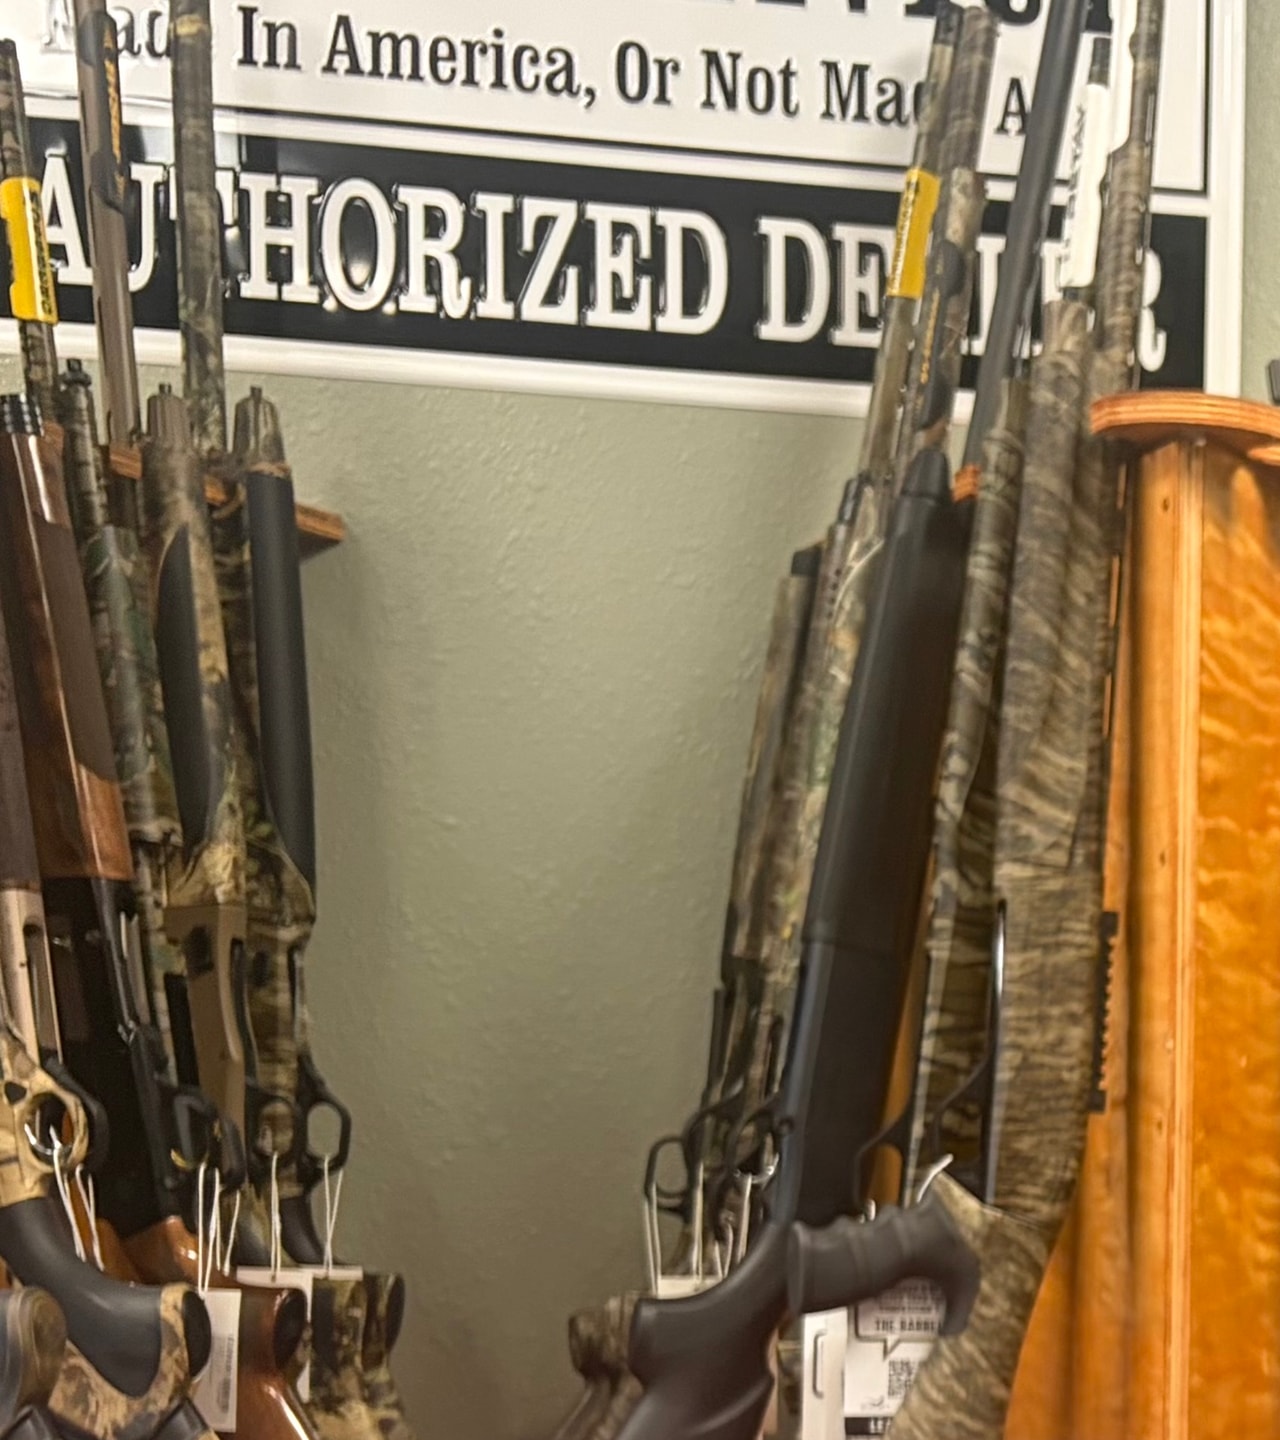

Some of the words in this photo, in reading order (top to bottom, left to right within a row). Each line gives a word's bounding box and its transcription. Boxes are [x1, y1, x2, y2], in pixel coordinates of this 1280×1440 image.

[237, 6, 302, 70] In
[321, 15, 597, 108] America,
[614, 42, 680, 105] Or
[698, 48, 800, 119] Not
